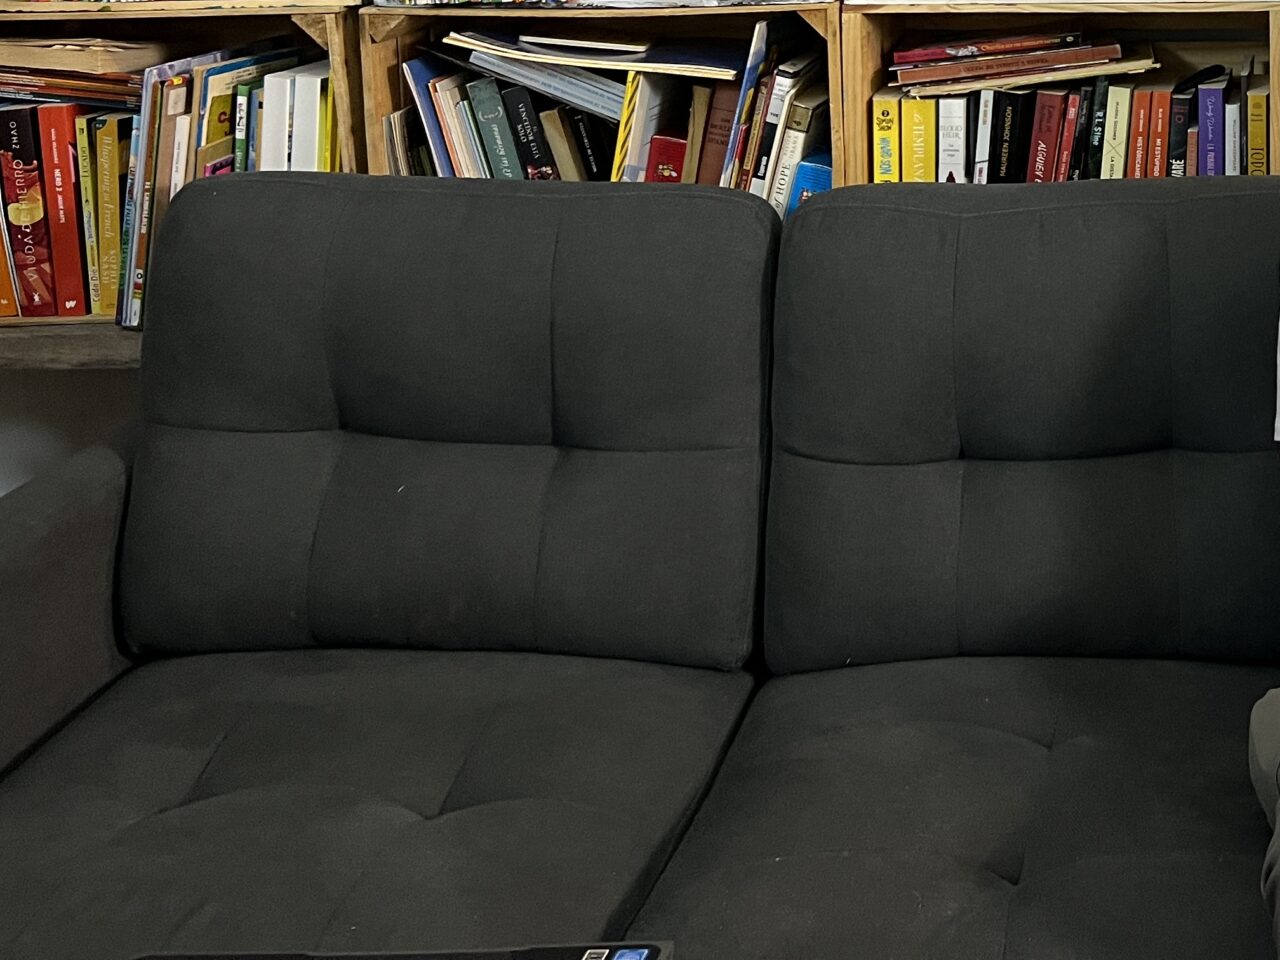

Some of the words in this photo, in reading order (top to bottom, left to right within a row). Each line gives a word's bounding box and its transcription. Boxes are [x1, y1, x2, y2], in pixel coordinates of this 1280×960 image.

[9, 120, 20, 150] ZHAO
[516, 123, 526, 143] SOLO
[517, 102, 537, 141] VENCEDOR
[1002, 105, 1014, 141] JOHNSON
[1093, 126, 1102, 146] Stine
[999, 142, 1009, 177] MAUREEN
[1034, 140, 1047, 177] ALGUIEN
[1153, 146, 1162, 177] ESTÚPIDO
[776, 162, 791, 196] HOPE
